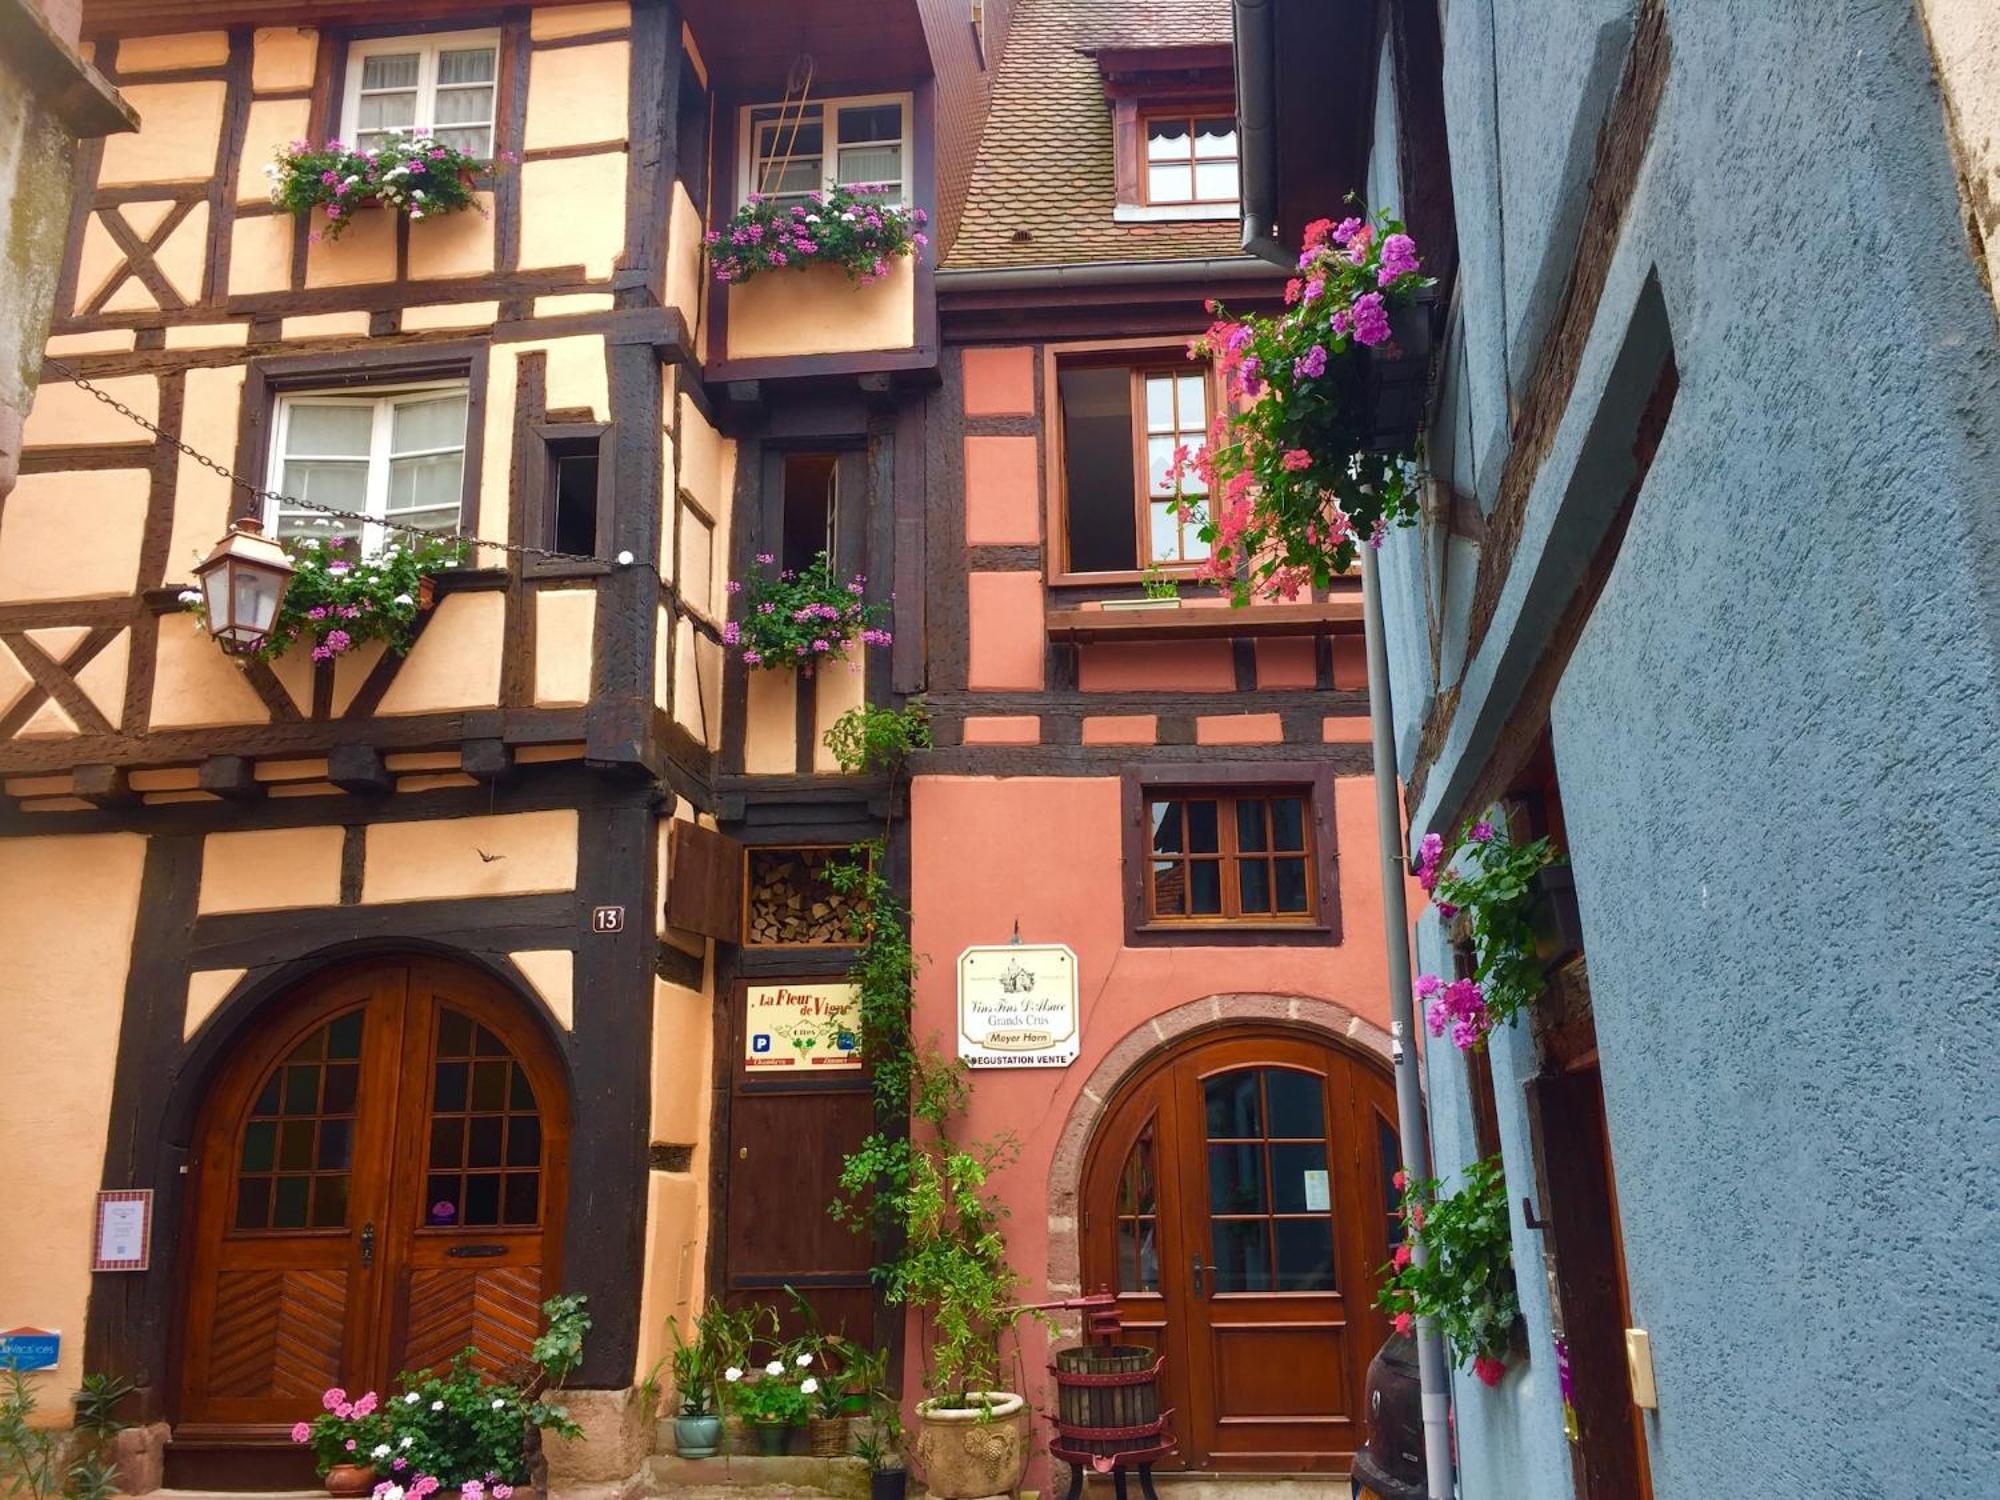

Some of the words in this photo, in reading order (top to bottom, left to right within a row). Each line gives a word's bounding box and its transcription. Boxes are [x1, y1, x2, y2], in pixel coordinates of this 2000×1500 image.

[598, 911, 617, 929] 13
[759, 994, 774, 1007] La
[776, 989, 812, 1006] Fleur
[800, 1006, 813, 1016] de
[988, 1015, 1023, 1026] Grands
[1026, 1015, 1049, 1025] Crus
[757, 1038, 769, 1050] P
[1037, 1055, 1067, 1064] VENTE
